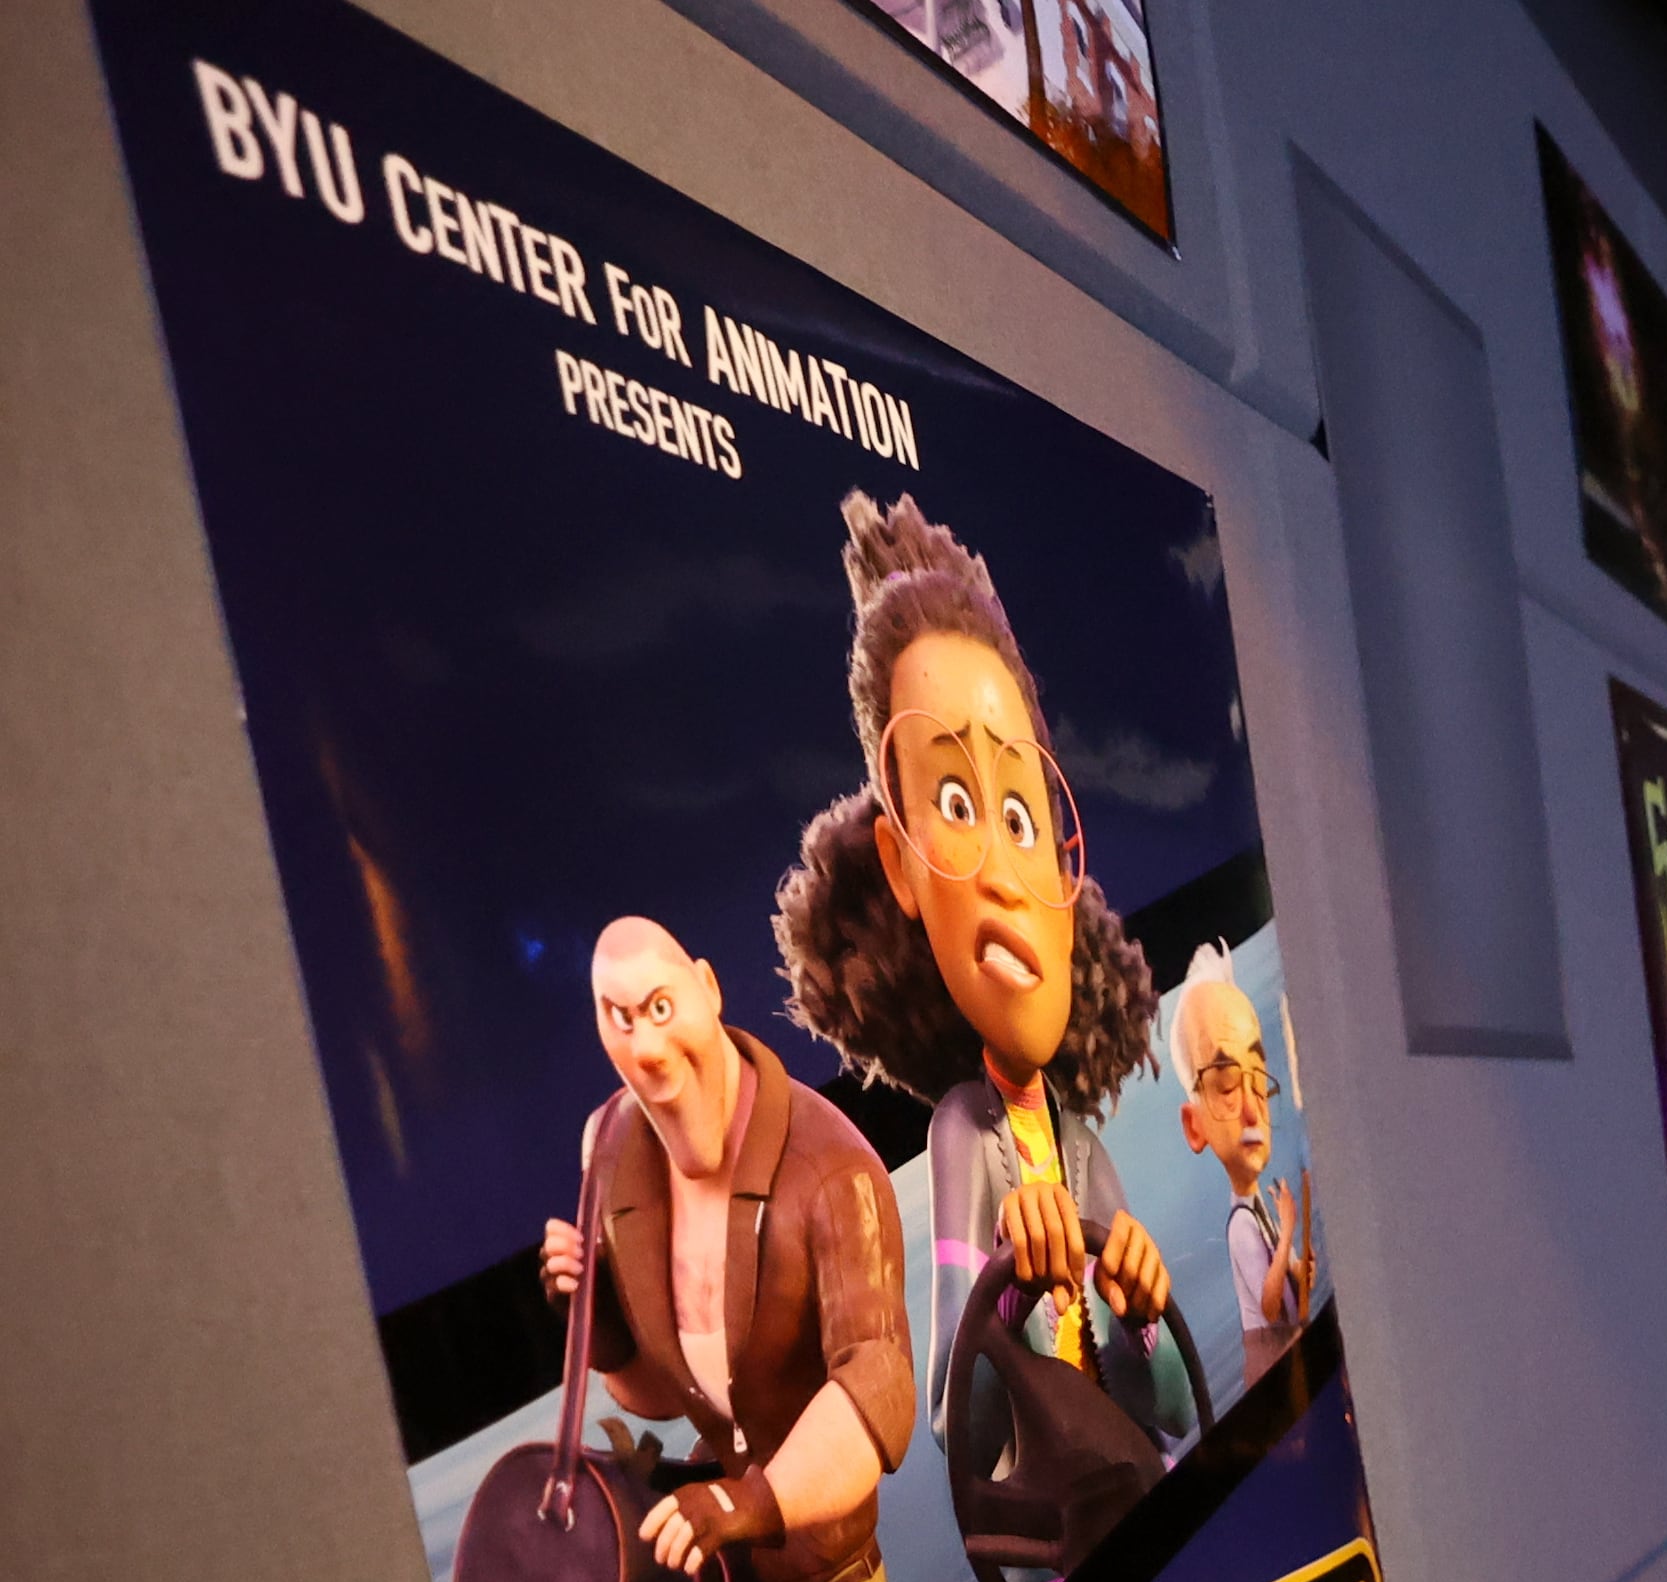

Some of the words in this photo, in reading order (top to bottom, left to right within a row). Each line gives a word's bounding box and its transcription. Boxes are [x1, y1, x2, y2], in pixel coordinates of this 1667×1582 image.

[194, 60, 364, 225] BYU
[382, 153, 597, 327] CENTER
[704, 304, 921, 472] ANIMATION
[555, 348, 744, 481] PRESENTS
